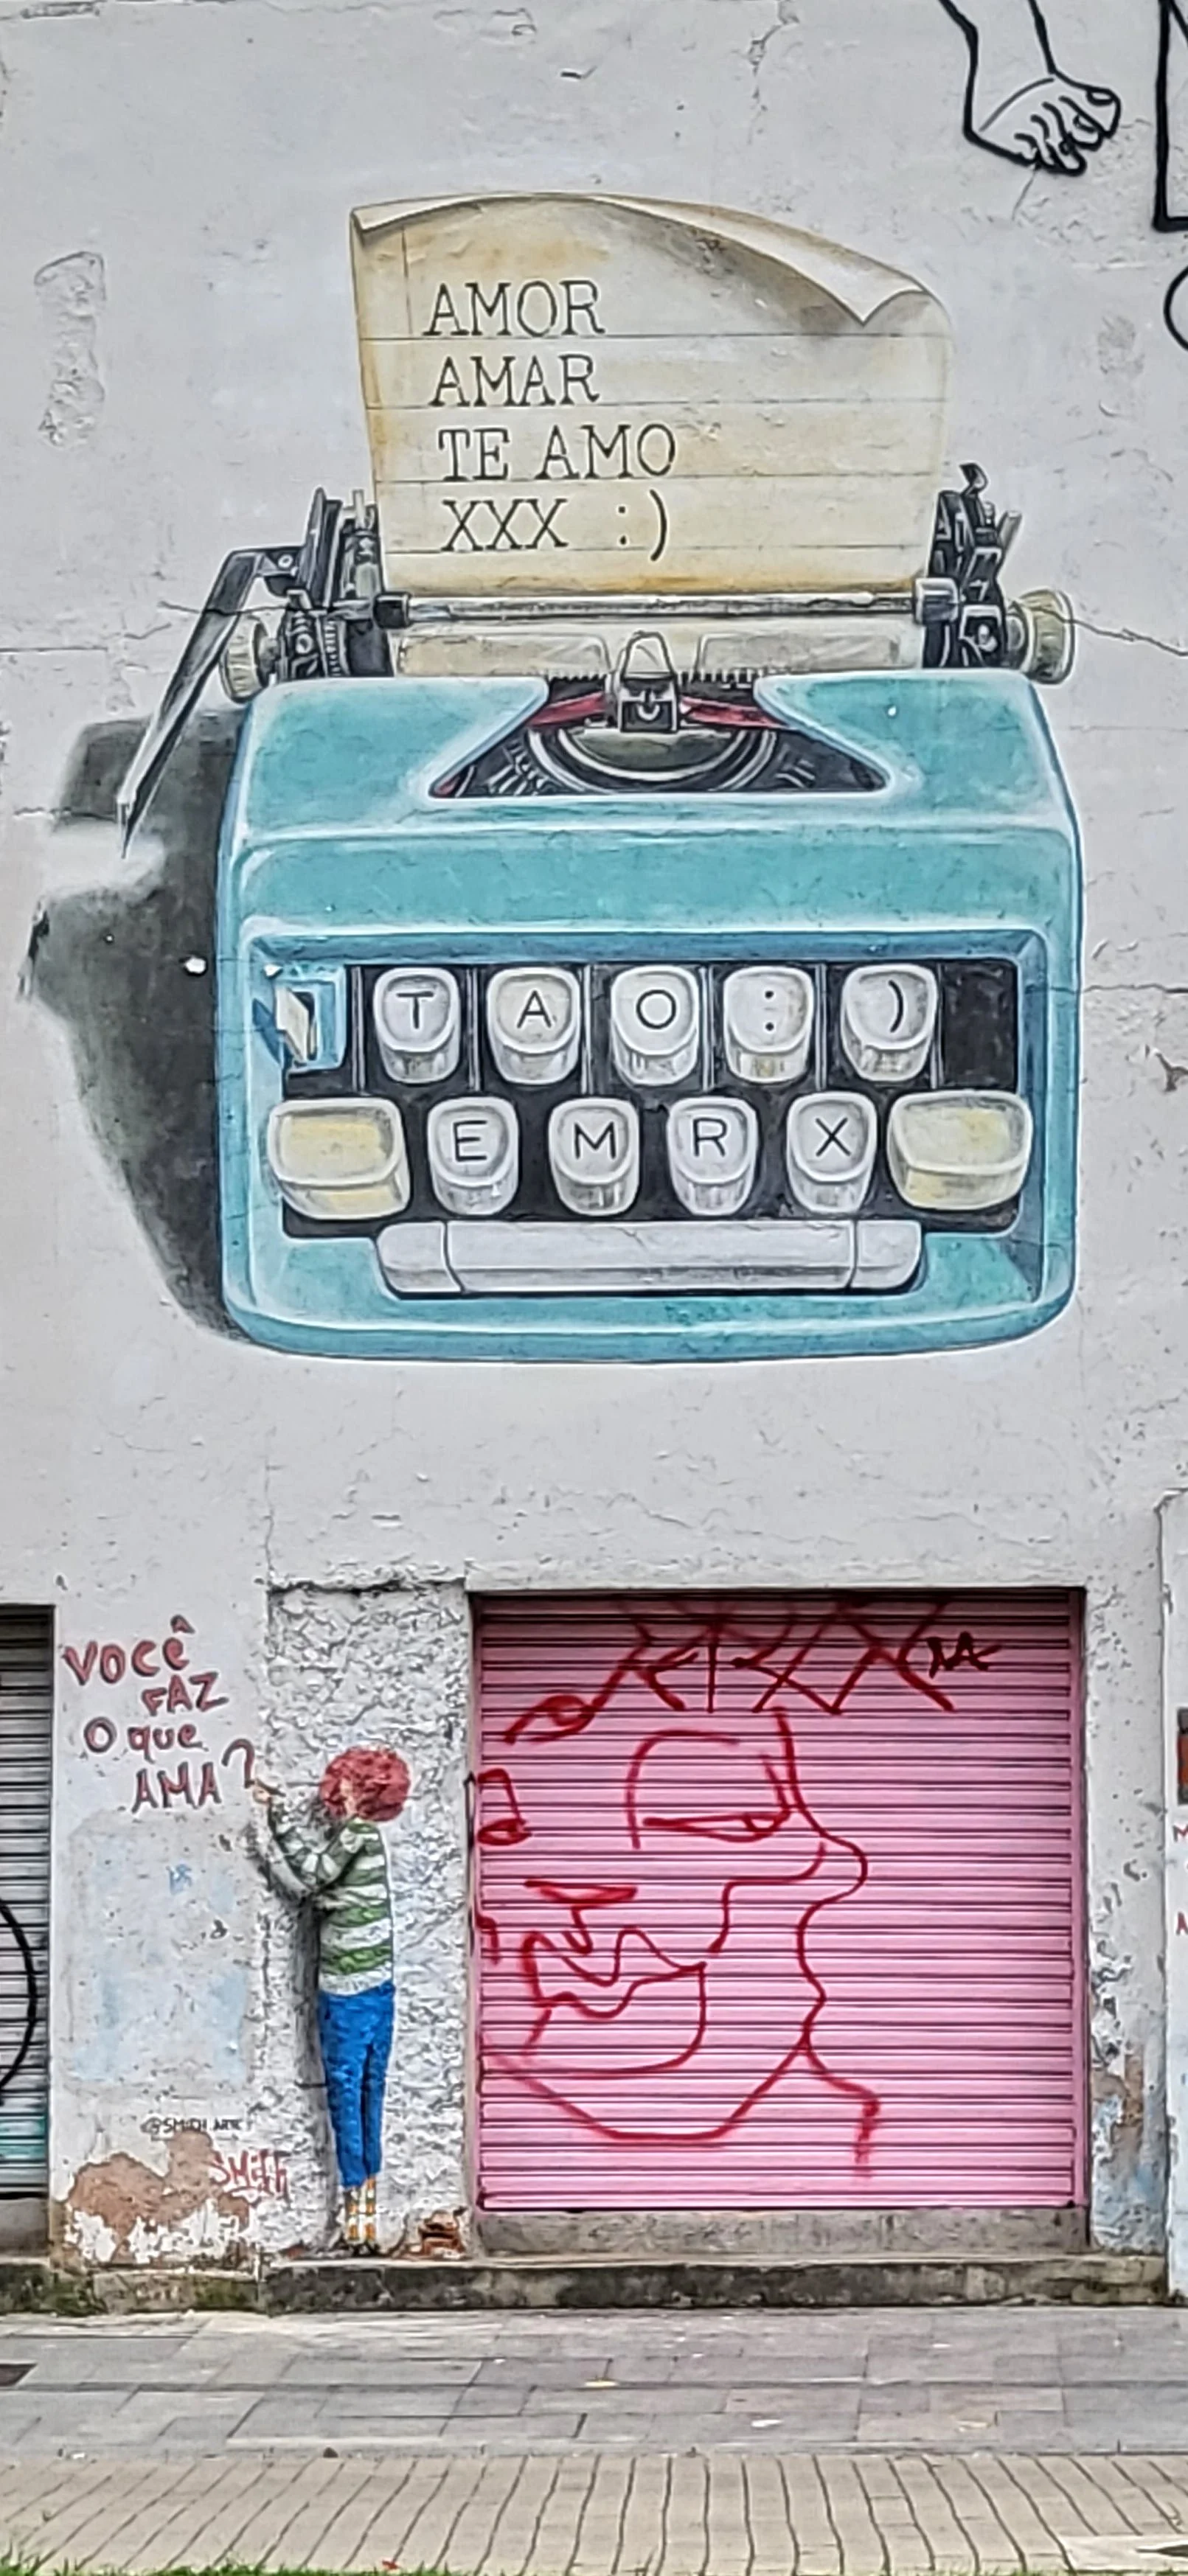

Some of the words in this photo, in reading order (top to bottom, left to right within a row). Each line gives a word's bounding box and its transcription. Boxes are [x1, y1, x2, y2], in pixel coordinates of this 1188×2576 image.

[423, 280, 605, 337] AMOR
[428, 355, 600, 406] AMAR
[439, 428, 510, 481] TE
[535, 423, 675, 479] AMO
[442, 498, 568, 551] XXX
[618, 490, 667, 561] :)
[397, 991, 434, 1029] T
[516, 990, 554, 1028] A
[636, 989, 677, 1030] O
[455, 1119, 487, 1162] E
[574, 1121, 616, 1160] M
[692, 1118, 726, 1156] R
[815, 1118, 851, 1156] X
[142, 1671, 229, 1716] FAZ
[83, 1716, 117, 1753] O
[127, 1723, 209, 1764] que
